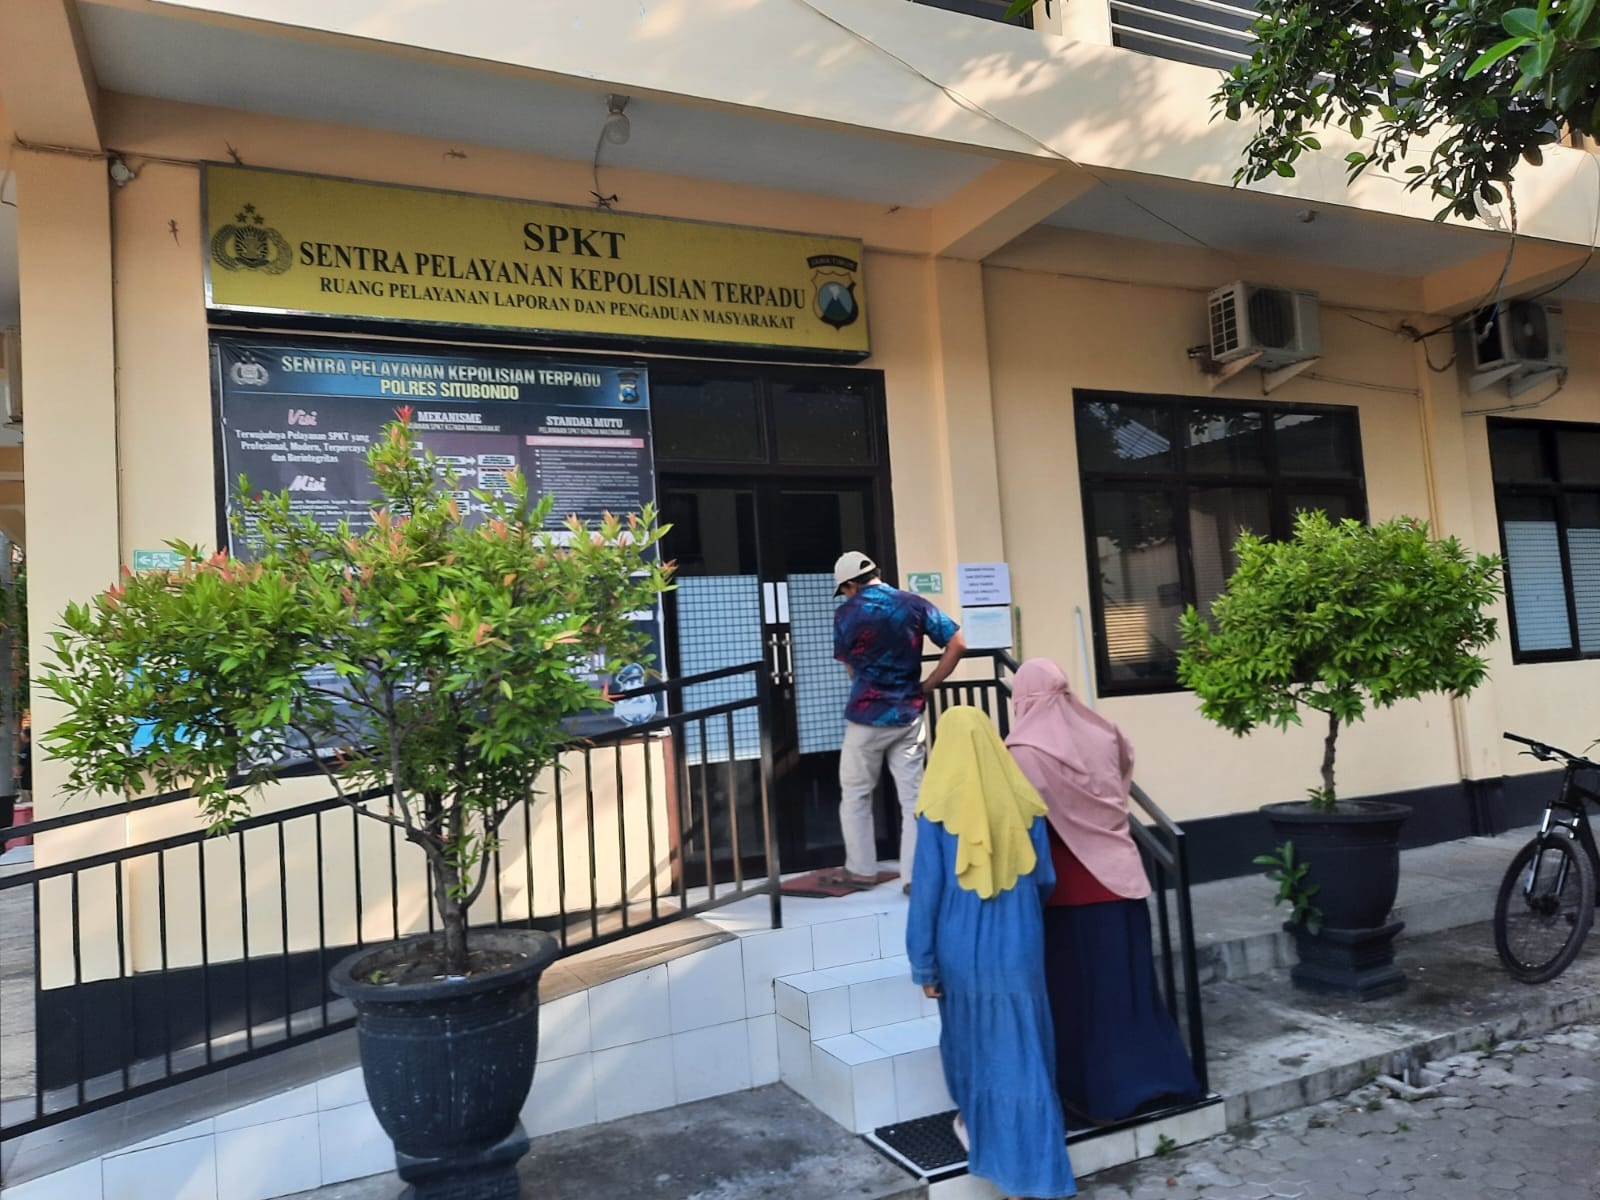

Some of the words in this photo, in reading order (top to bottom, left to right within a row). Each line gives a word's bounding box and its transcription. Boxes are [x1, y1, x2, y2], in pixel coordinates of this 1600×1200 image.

[523, 222, 626, 260] SPKT
[299, 241, 408, 275] SENTRA
[415, 252, 563, 289] PELAYANAN
[571, 267, 707, 302] KEPOLISIAN
[711, 280, 806, 310] TERPADU
[320, 276, 384, 298] RUANG
[389, 283, 490, 306] PELAYANAN
[495, 292, 571, 312] LAPORAN
[574, 298, 606, 315] DAN
[610, 302, 700, 323] PENGADUAN
[703, 309, 796, 330] MASYARAKAT
[281, 355, 347, 374] SENTRA
[351, 359, 445, 380] PELAYANAN
[448, 365, 536, 385] KEPOLISIAN
[538, 369, 602, 388] TERPADU
[380, 378, 436, 397] POLRES
[440, 381, 520, 400] SITUBONDO
[287, 408, 318, 426] Visi
[417, 411, 483, 424] MEKANISME
[546, 415, 593, 428] STANDAR
[594, 417, 623, 429] MUTU
[327, 432, 349, 441] SPKT
